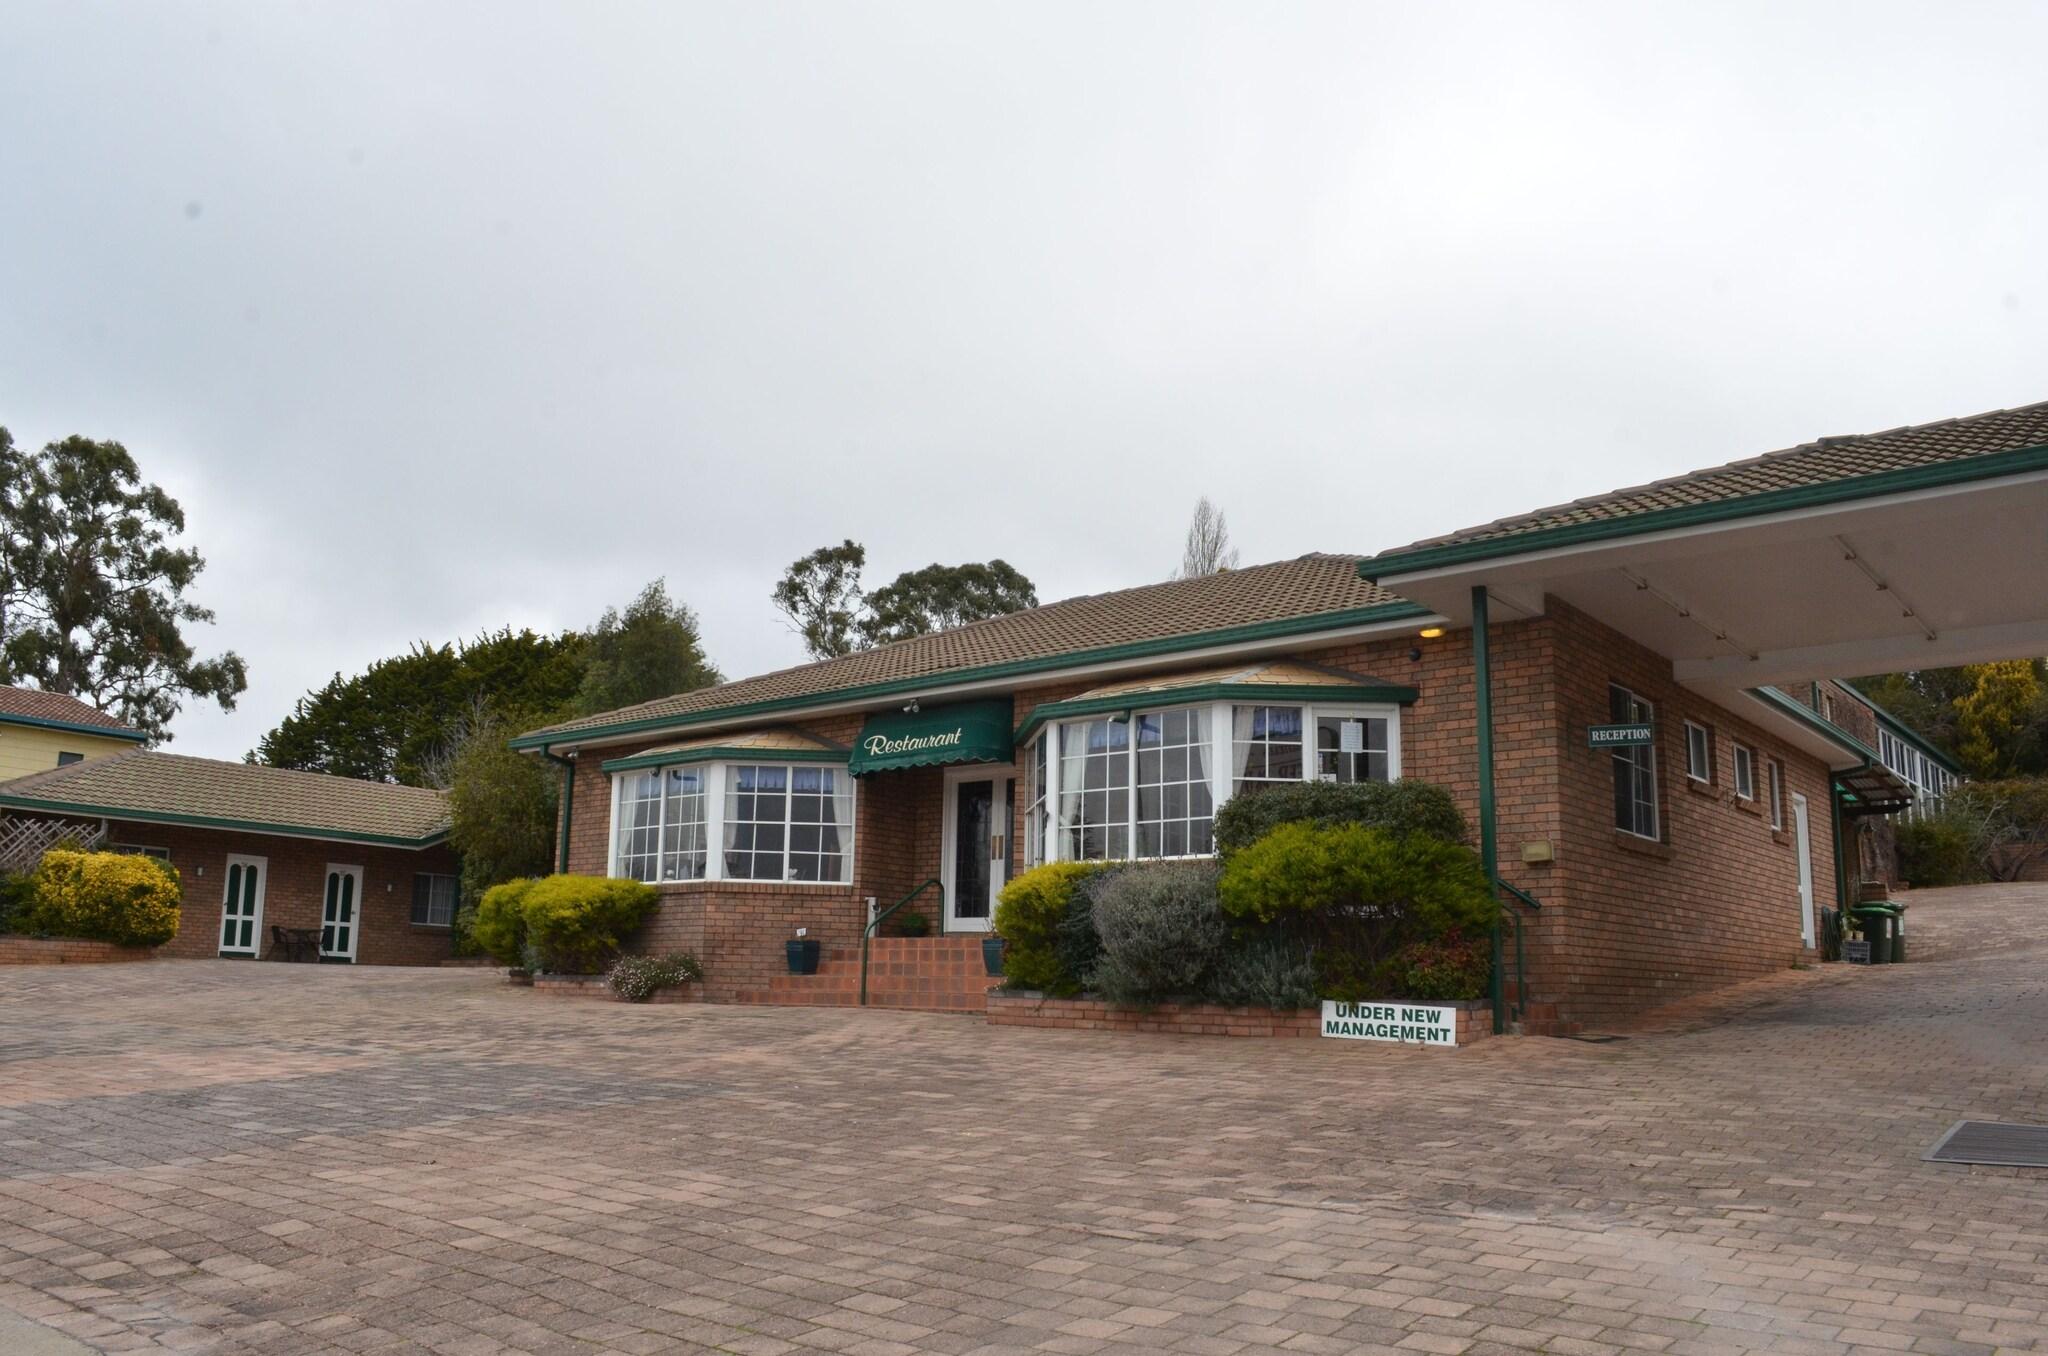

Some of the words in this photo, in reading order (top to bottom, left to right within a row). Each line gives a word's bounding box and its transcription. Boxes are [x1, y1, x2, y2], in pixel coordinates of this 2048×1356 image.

[864, 728, 962, 756] Restaurant
[1591, 728, 1652, 742] RECEPTION
[1335, 1003, 1396, 1021] UNDER
[1401, 1008, 1442, 1024] NEW
[1326, 1020, 1451, 1042] MANAGEMENT
